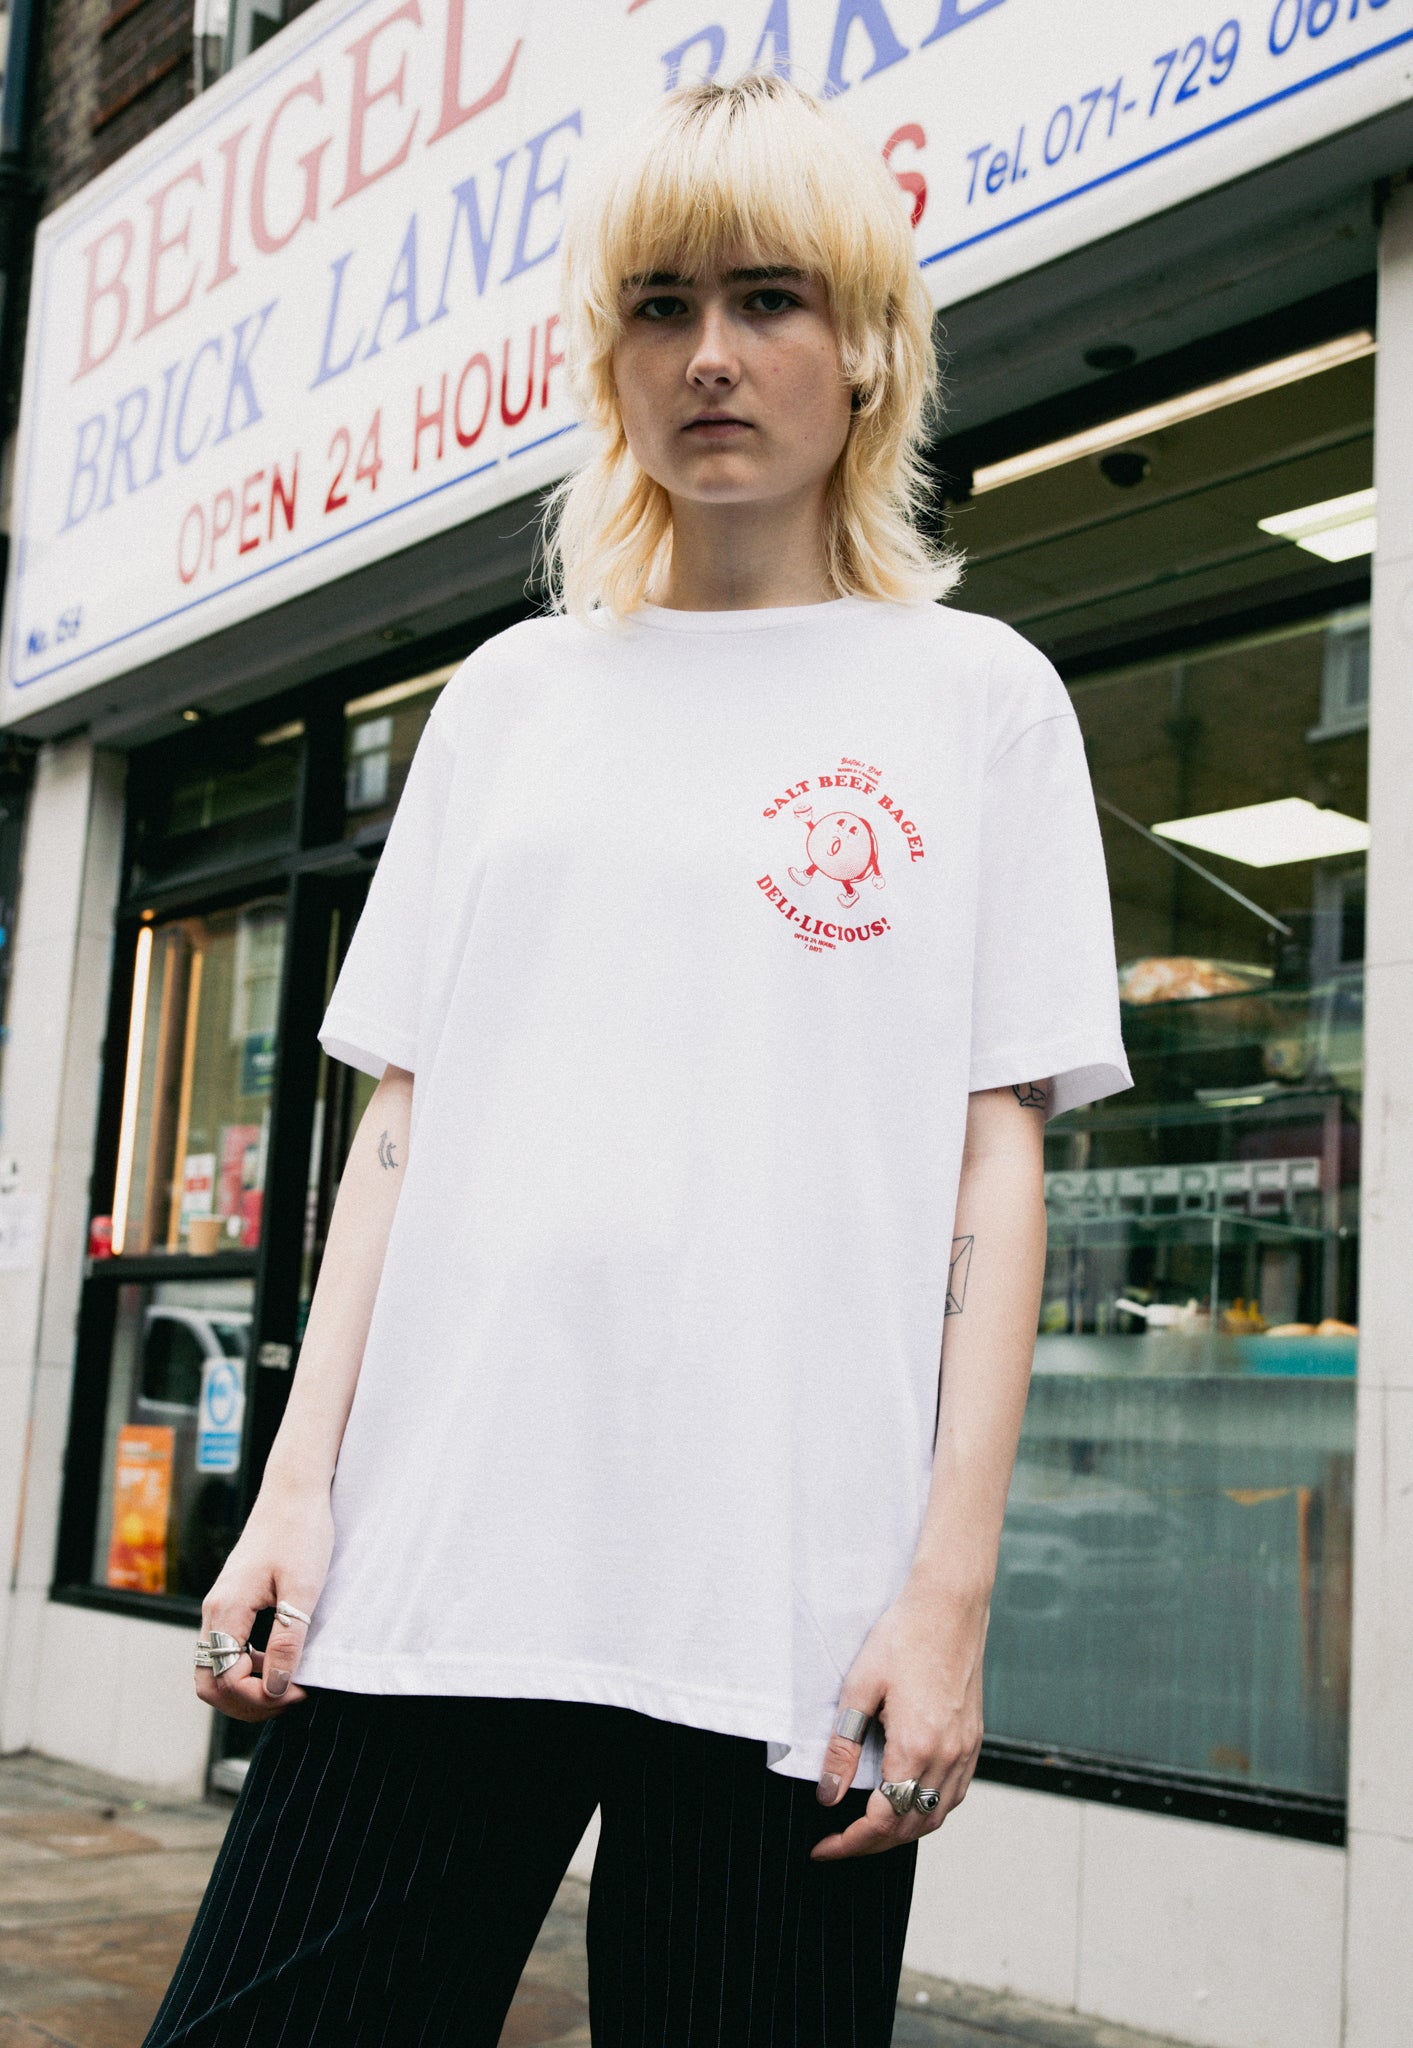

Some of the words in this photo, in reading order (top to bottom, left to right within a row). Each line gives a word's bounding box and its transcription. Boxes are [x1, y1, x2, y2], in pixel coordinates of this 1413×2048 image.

[71, 0, 523, 383] BEIGEL
[966, 124, 1028, 205] Tel.
[1043, 18, 1241, 166] 071-729
[60, 299, 279, 534] BRICK
[309, 109, 582, 390] LANE
[177, 453, 299, 585] OPEN
[324, 407, 383, 515] 24
[756, 874, 892, 943] DELI-LICIOUS!
[763, 780, 810, 819] SALT
[818, 775, 877, 796] BEEF
[878, 794, 925, 862] BAGEL
